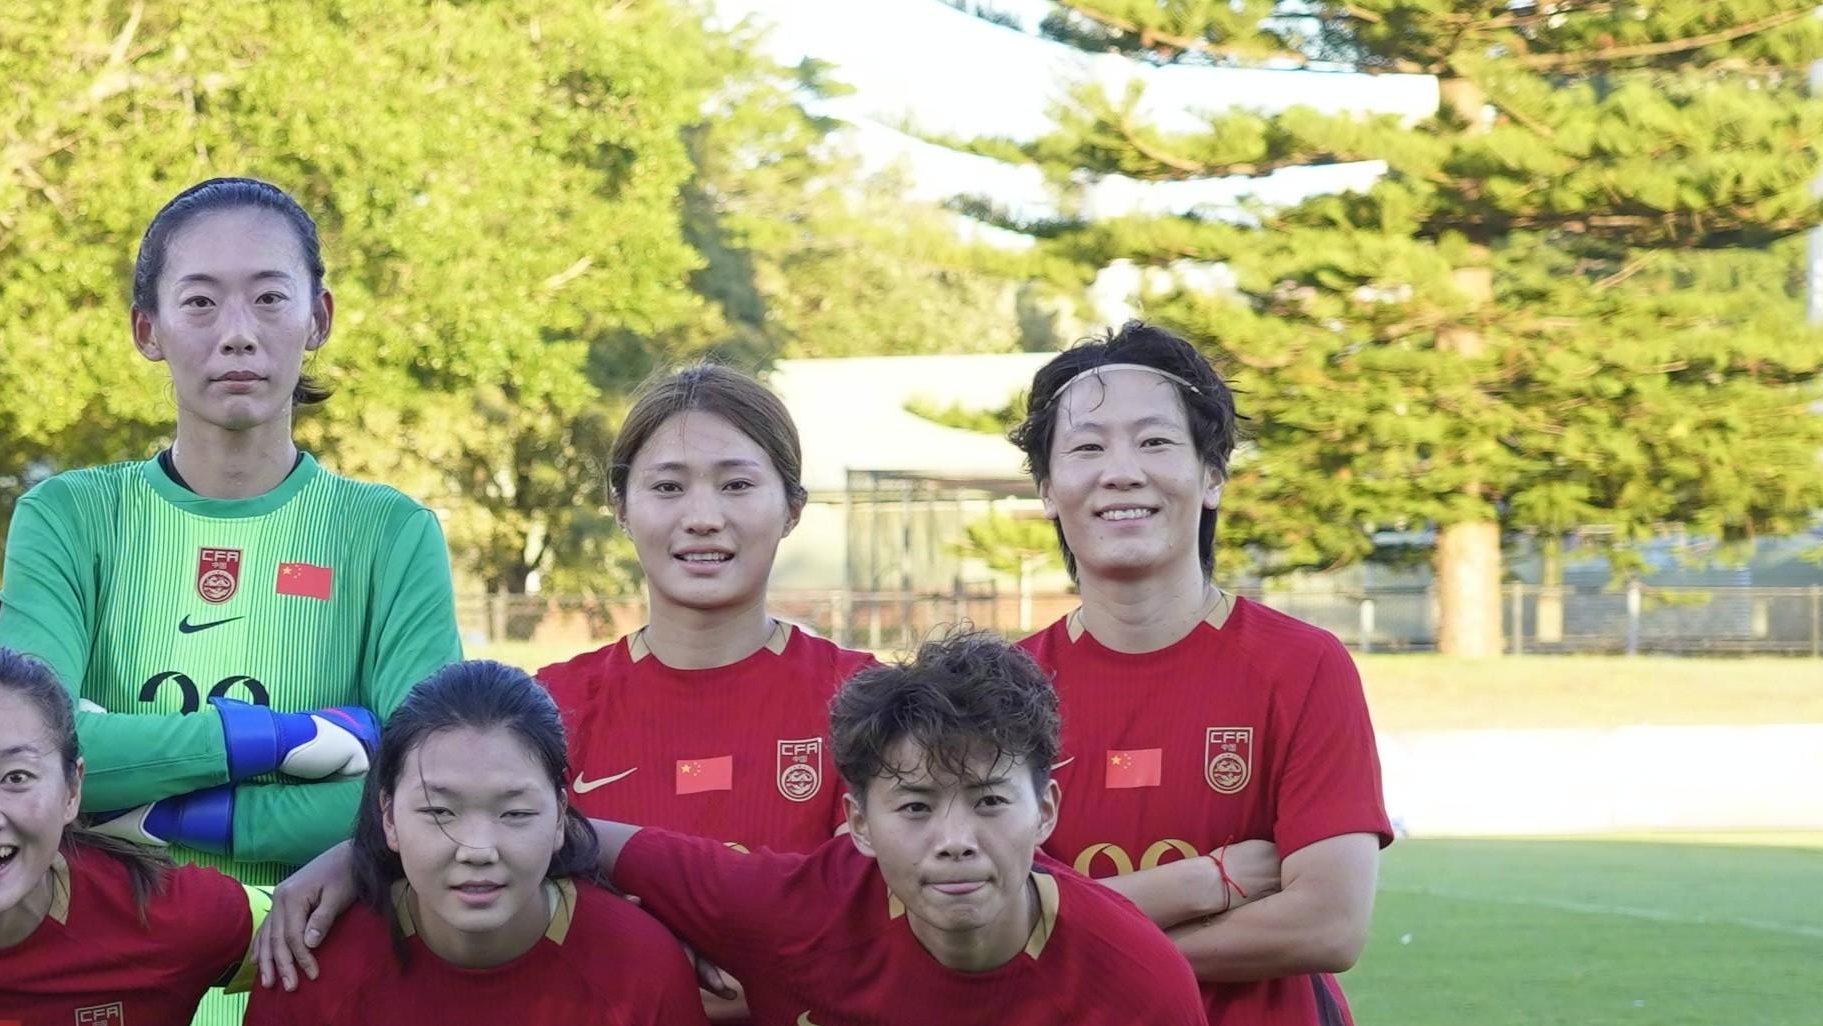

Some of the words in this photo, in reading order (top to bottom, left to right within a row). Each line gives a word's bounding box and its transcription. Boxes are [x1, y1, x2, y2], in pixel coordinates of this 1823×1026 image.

[201, 550, 239, 562] CFA
[1210, 732, 1248, 744] CFA
[781, 742, 818, 756] CFA
[80, 1007, 118, 1023] CFA
